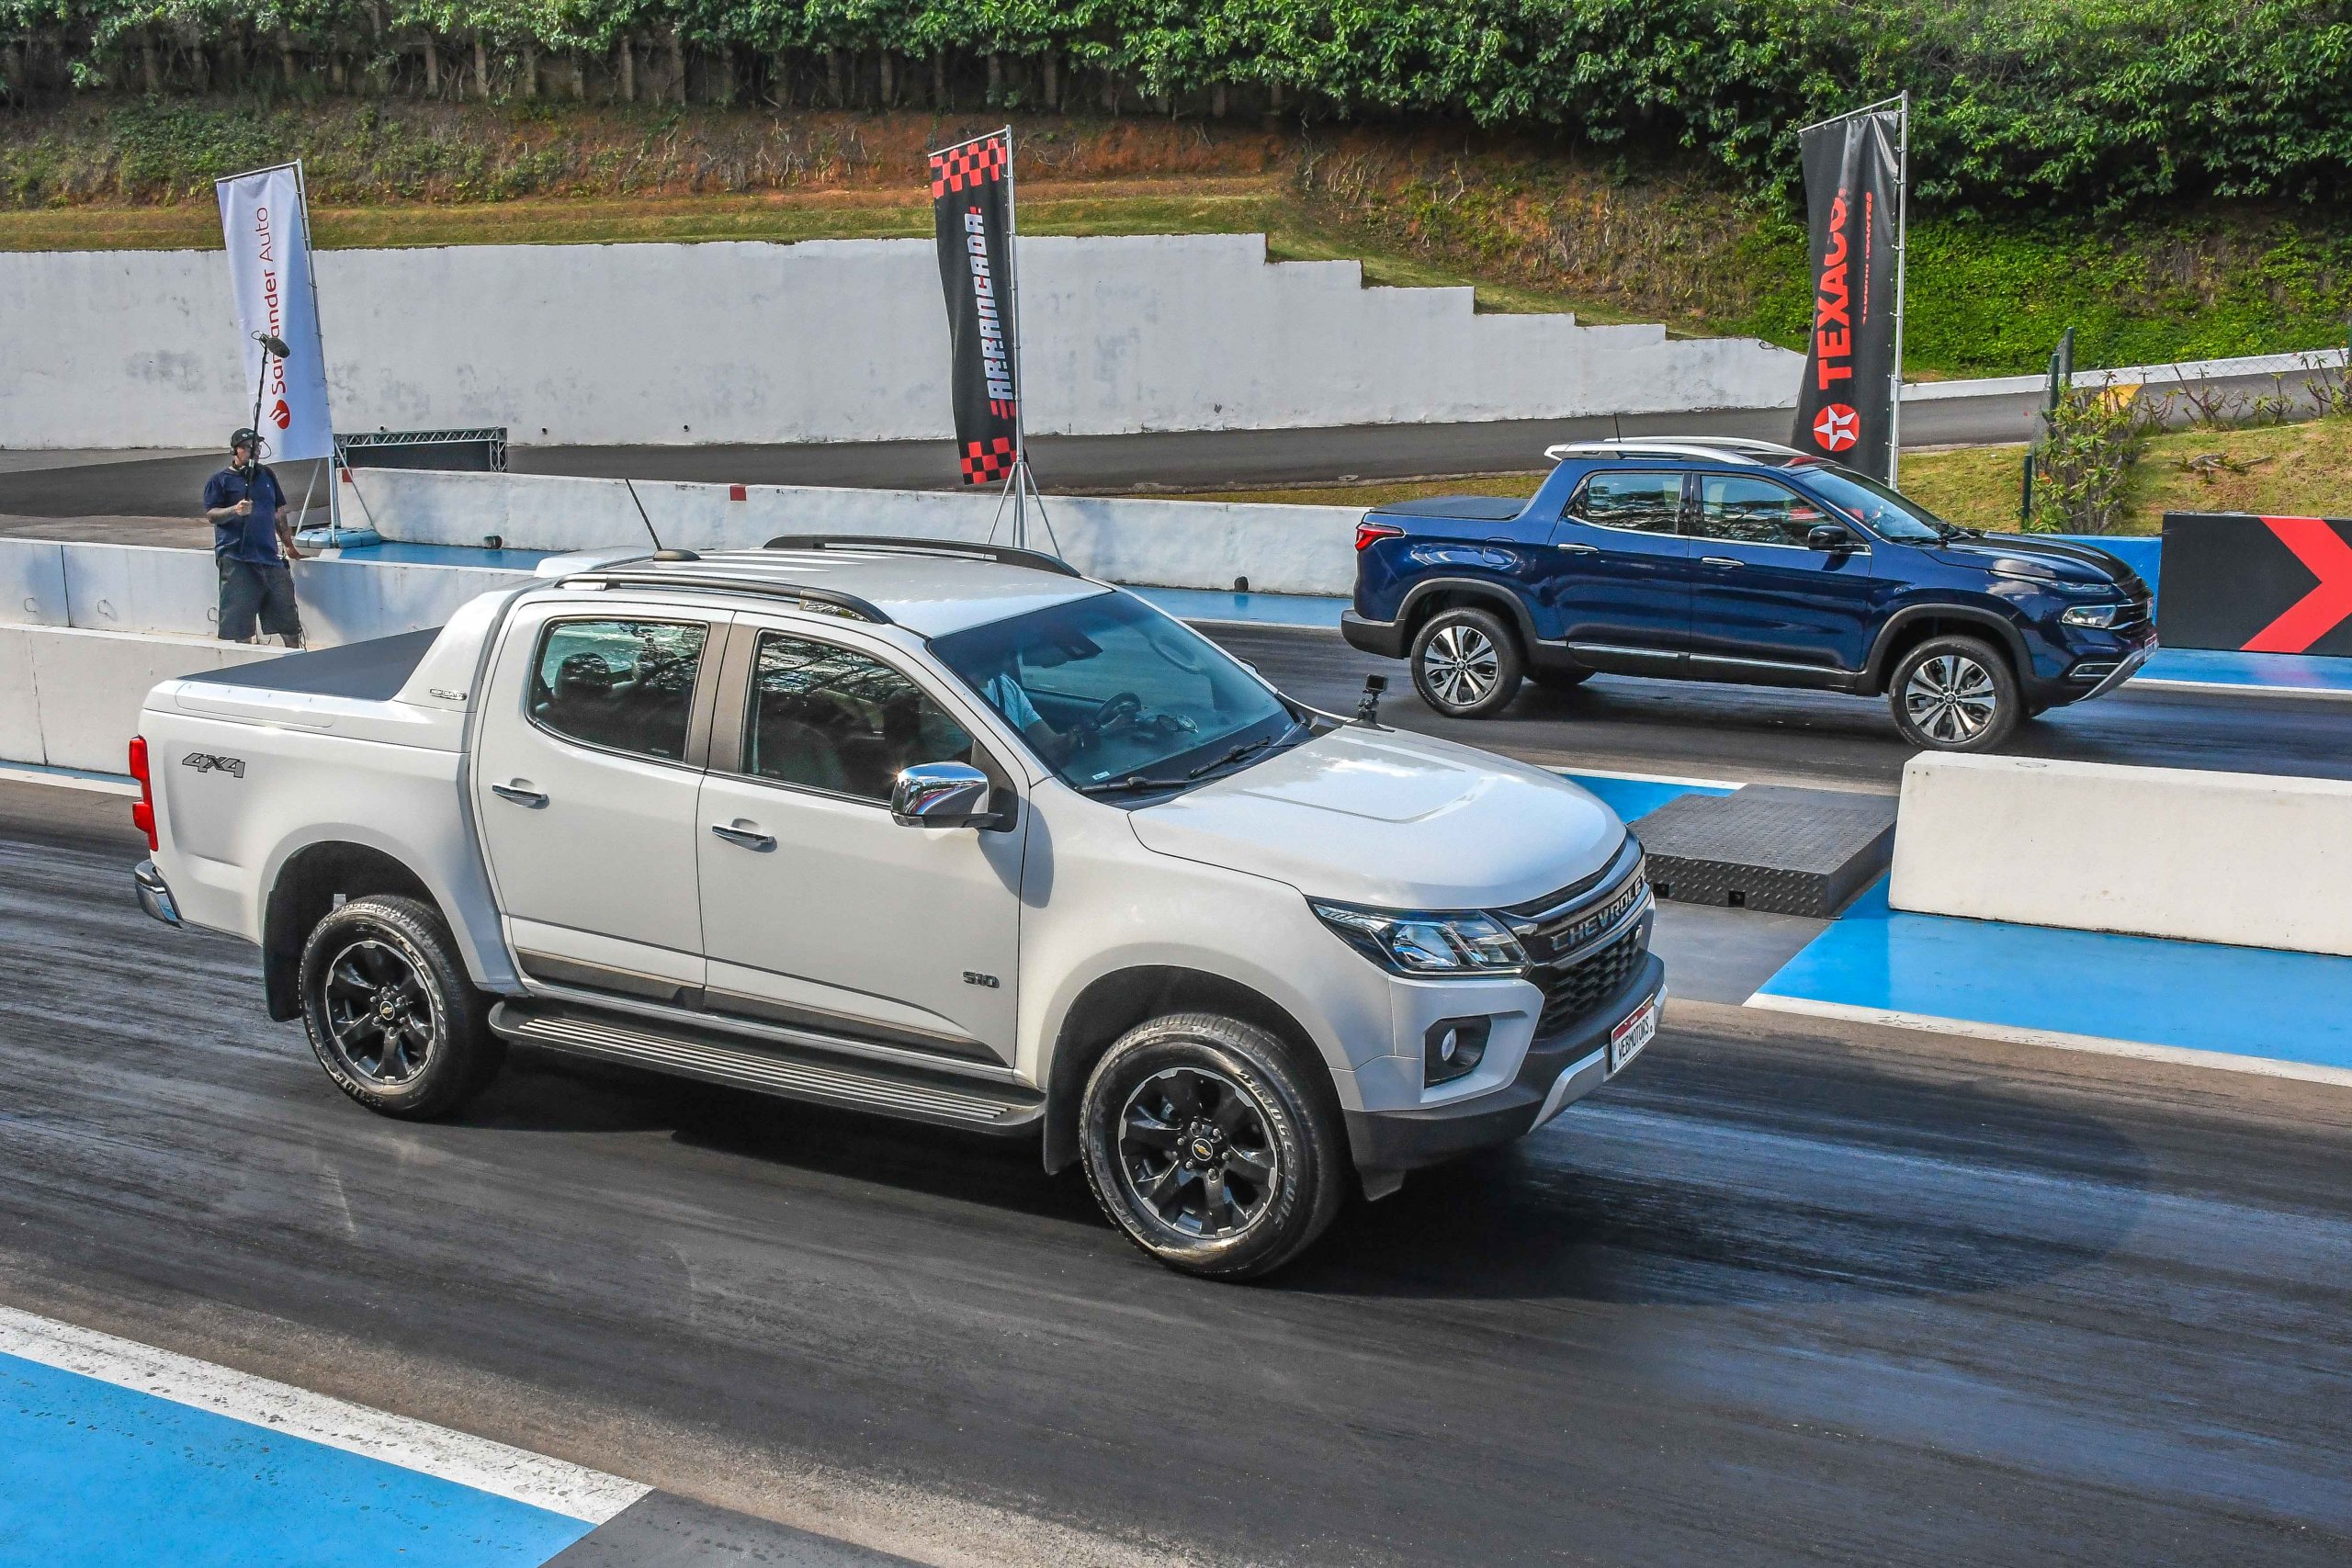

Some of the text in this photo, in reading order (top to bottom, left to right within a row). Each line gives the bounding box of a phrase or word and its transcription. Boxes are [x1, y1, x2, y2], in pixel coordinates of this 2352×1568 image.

[255, 207, 287, 395] Sanander Auto
[964, 212, 1014, 400] ARRANCADA
[1816, 195, 1852, 389] TEXACO
[963, 971, 1001, 988] S10
[1551, 869, 1646, 952] CHEVROLET
